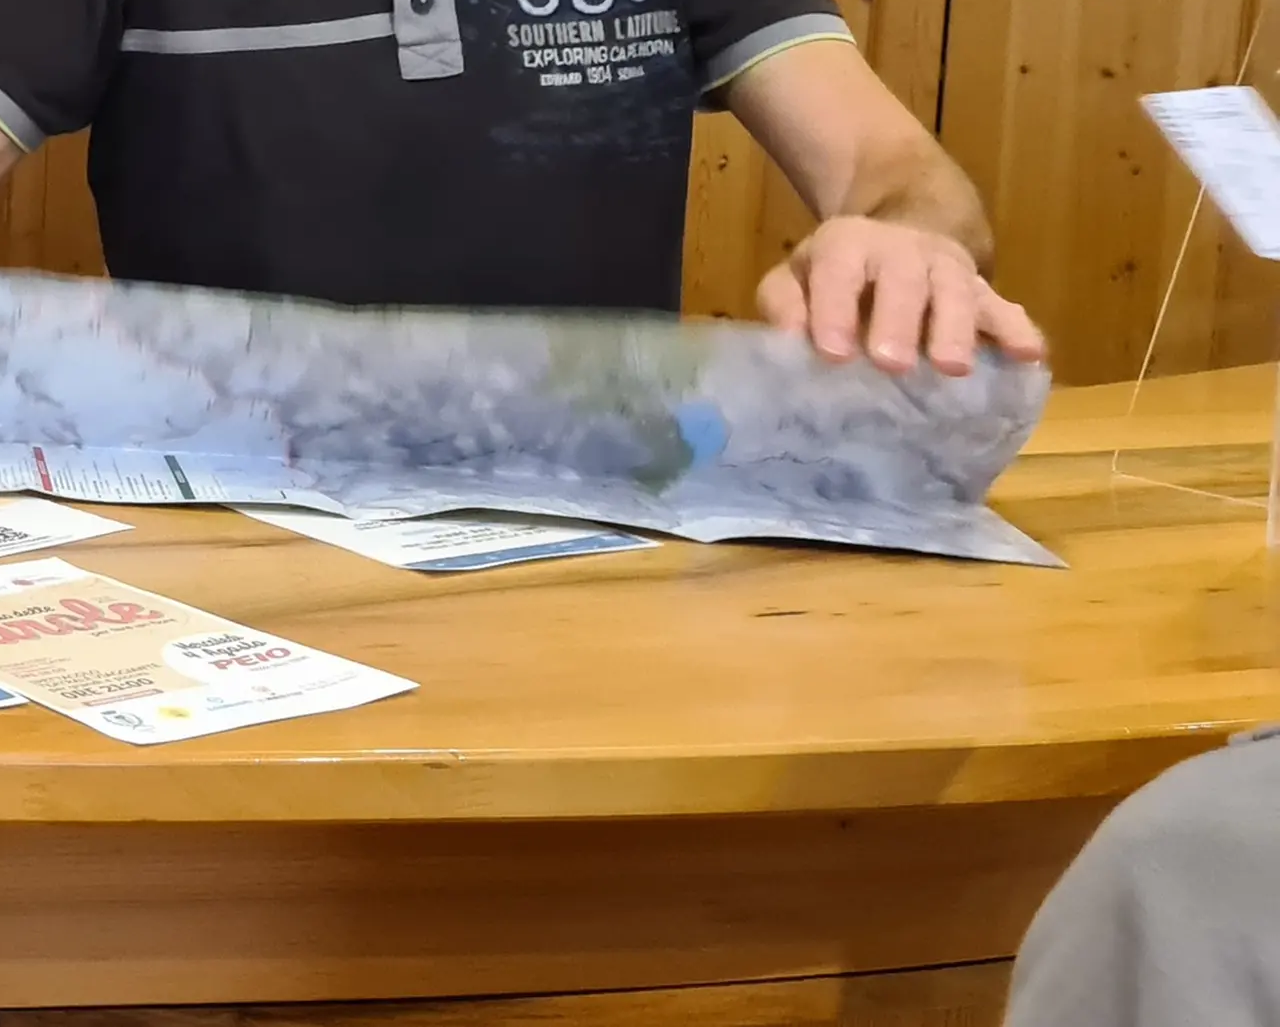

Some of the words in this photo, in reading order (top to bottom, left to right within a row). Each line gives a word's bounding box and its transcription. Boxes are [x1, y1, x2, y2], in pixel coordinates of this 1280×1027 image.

[507, 20, 605, 47] SOUTHERN
[523, 46, 608, 68] EXPLORING
[208, 647, 292, 670] PEIO
[61, 686, 99, 700] ORE
[100, 678, 154, 692] 21:00
